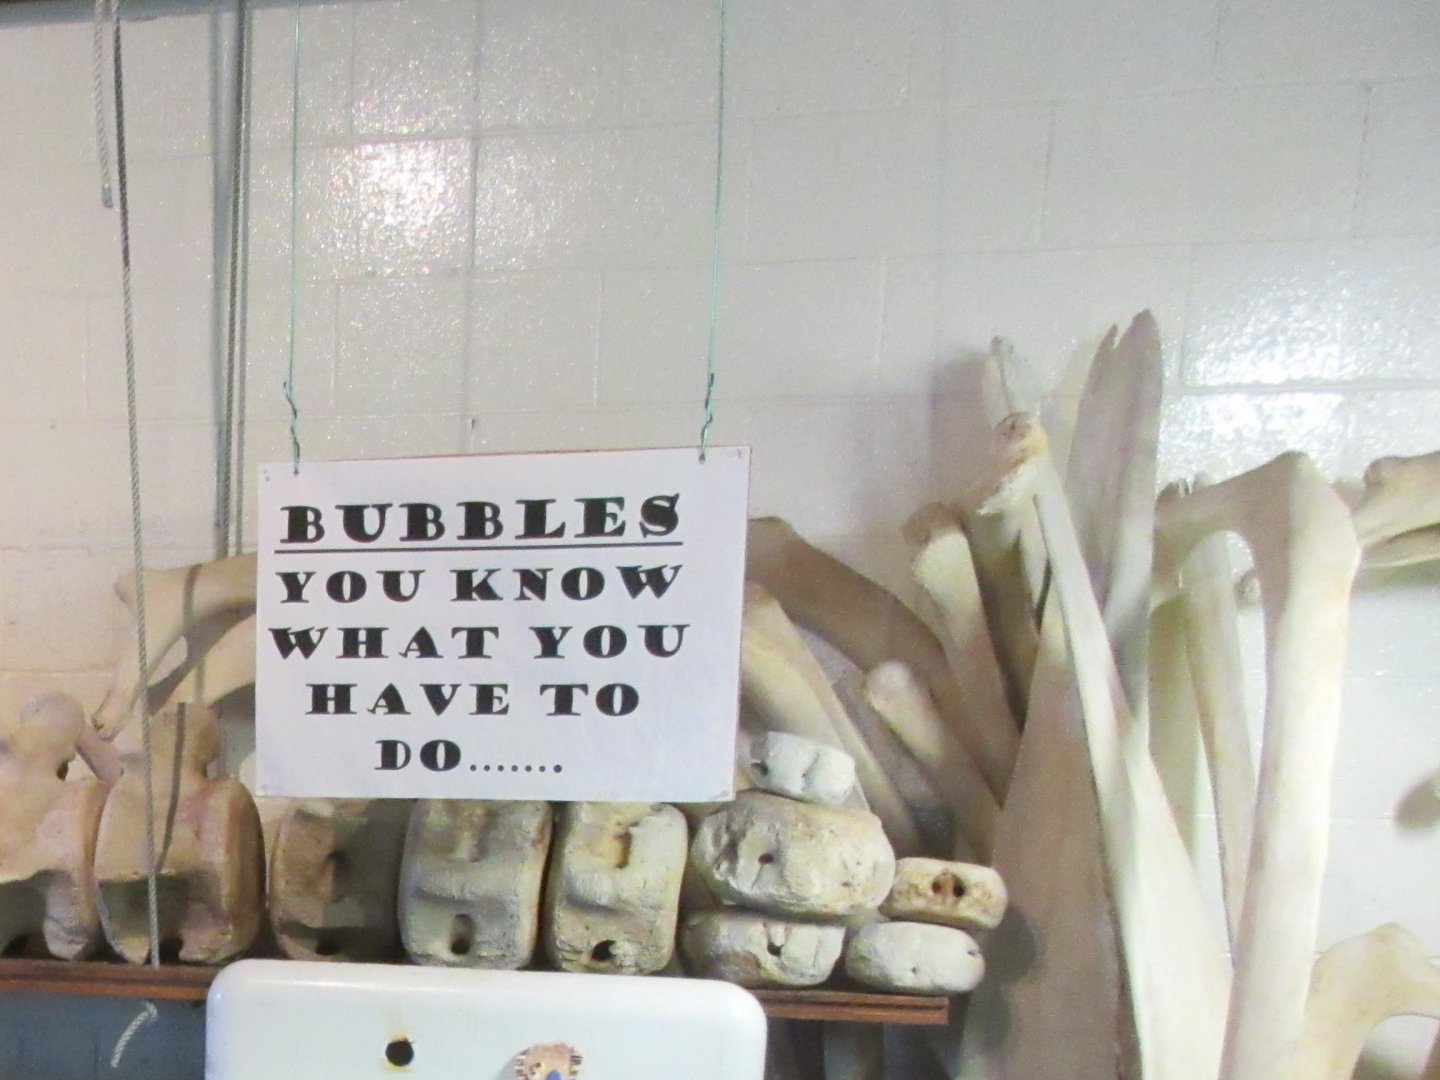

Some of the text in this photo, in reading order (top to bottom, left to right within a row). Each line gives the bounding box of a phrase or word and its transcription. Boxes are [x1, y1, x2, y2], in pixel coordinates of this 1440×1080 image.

[279, 493, 681, 544] BUBBLES
[275, 564, 683, 604] YOU KNOW
[269, 624, 690, 660] WHAT YOU
[305, 683, 640, 717] HAVE TO
